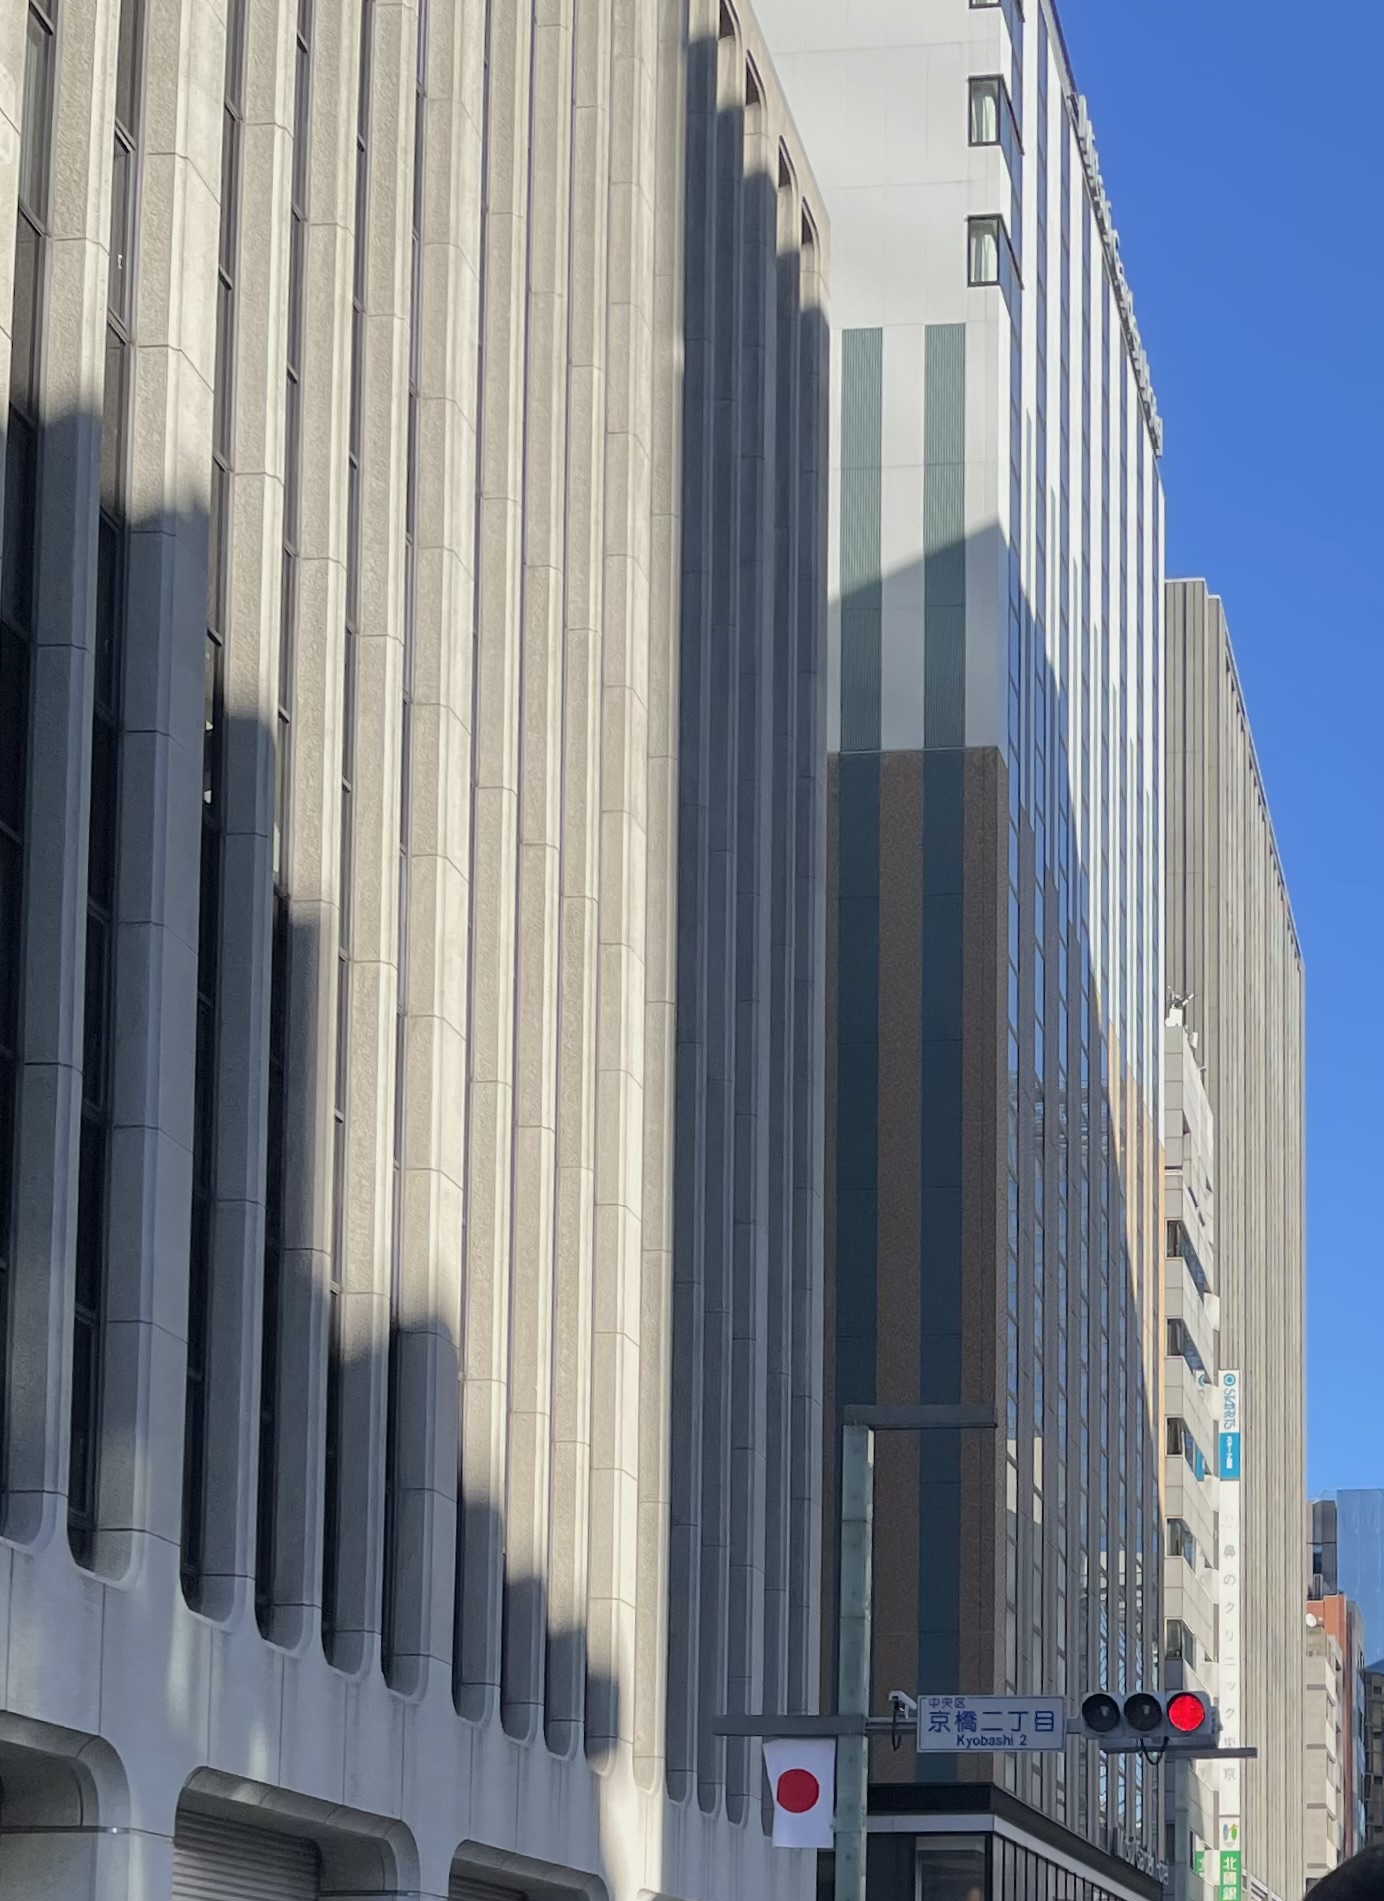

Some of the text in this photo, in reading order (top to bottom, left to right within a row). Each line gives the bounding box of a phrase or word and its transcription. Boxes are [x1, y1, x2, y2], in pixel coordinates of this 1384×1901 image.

[928, 1697, 966, 1709] 中央区
[928, 1710, 1055, 1733] 京橋二丁目
[956, 1734, 1028, 1749] Kyobashi 2
